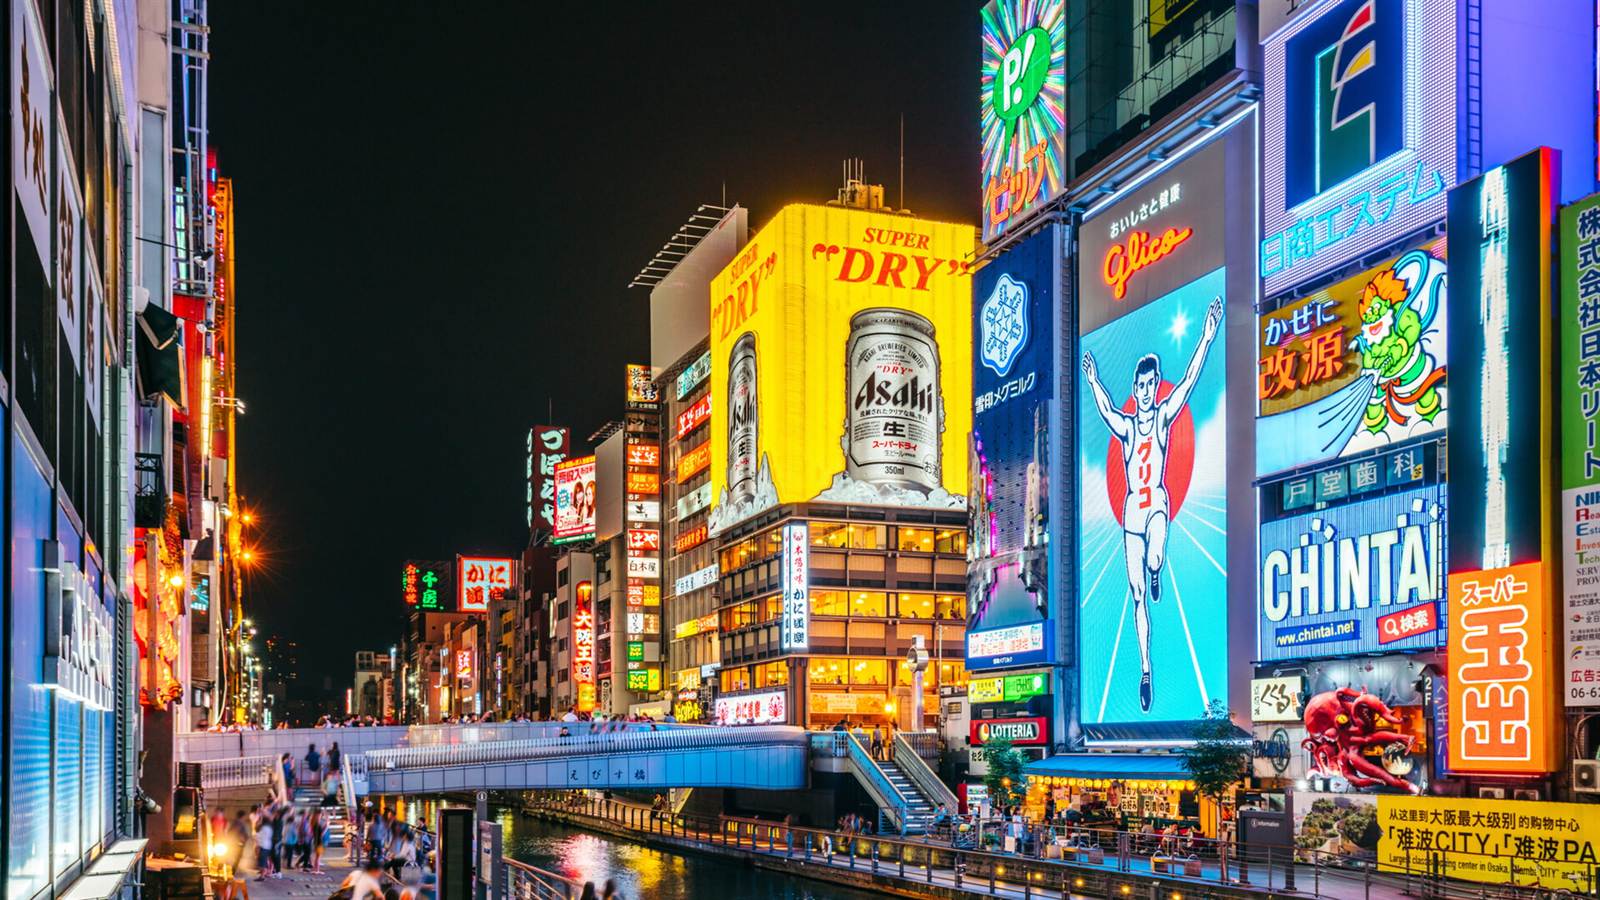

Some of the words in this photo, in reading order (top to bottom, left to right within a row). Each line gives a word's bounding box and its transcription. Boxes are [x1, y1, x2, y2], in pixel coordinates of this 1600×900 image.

[989, 138, 1048, 226] ピップ
[1110, 182, 1181, 239] おいしさと健康
[1261, 159, 1447, 279] 日商エステム
[863, 226, 931, 251] SUPER
[1264, 299, 1336, 346] かぜに
[1259, 326, 1345, 401] 改源
[854, 371, 933, 415] Asahi
[974, 371, 1036, 414] 雪印メグミルク
[882, 421, 906, 438] 生
[872, 440, 918, 451] スーパードライ
[884, 466, 905, 475] 350ml
[1137, 436, 1153, 510] グリコ
[466, 564, 506, 585] かに
[629, 561, 657, 573] 白木屋
[1460, 576, 1528, 606] スーパー
[1400, 609, 1430, 634] 検索
[1458, 604, 1533, 761] 玉出
[990, 723, 1034, 739] LOTTERIA
[570, 768, 646, 781] えびす橋
[1458, 861, 1479, 871] center
